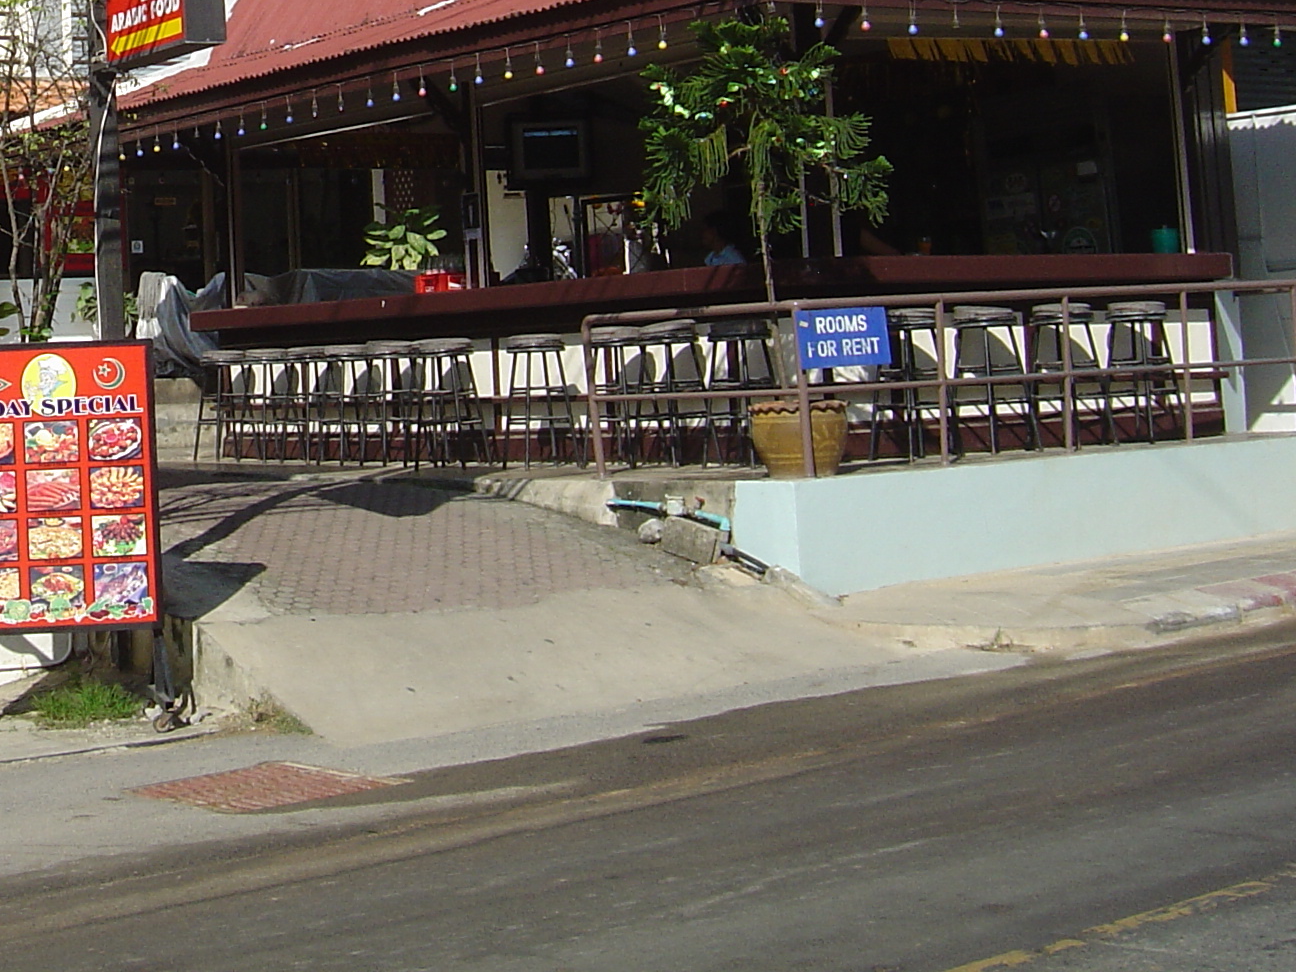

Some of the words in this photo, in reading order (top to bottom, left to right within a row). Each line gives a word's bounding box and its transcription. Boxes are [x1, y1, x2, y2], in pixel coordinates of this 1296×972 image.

[815, 314, 868, 335] ROOMS
[842, 337, 880, 356] RENT
[40, 395, 144, 417] SPECIAL
